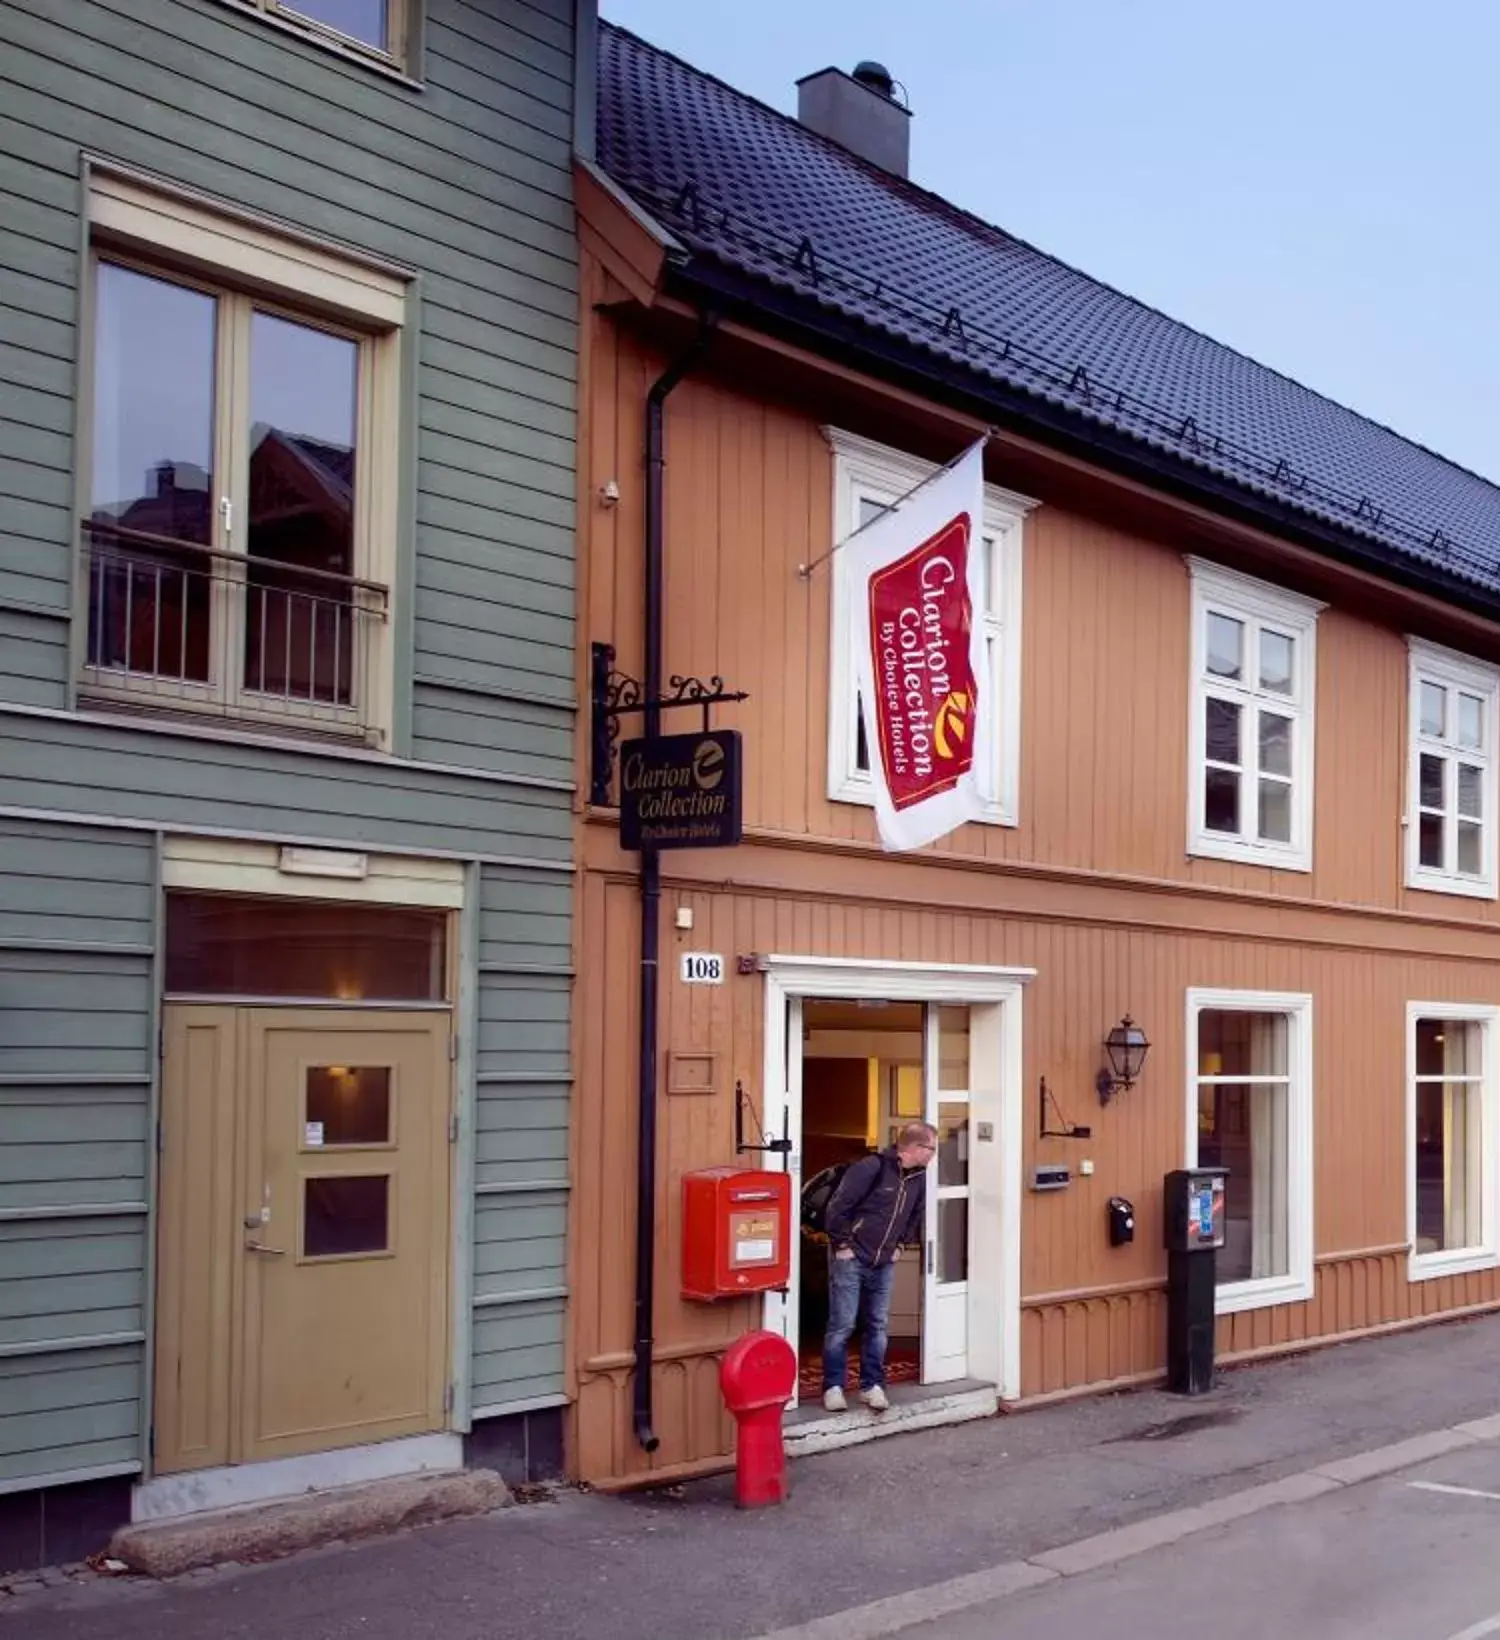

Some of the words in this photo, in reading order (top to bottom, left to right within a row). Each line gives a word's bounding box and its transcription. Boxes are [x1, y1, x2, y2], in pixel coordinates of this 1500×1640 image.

[880, 622, 896, 643] By
[921, 556, 955, 696] Clarion
[884, 648, 899, 711] Choice
[899, 607, 933, 776] Collection
[891, 716, 908, 774] Hotels
[623, 752, 691, 791] Clarion
[639, 790, 725, 819] Collection
[686, 957, 720, 979] 108
